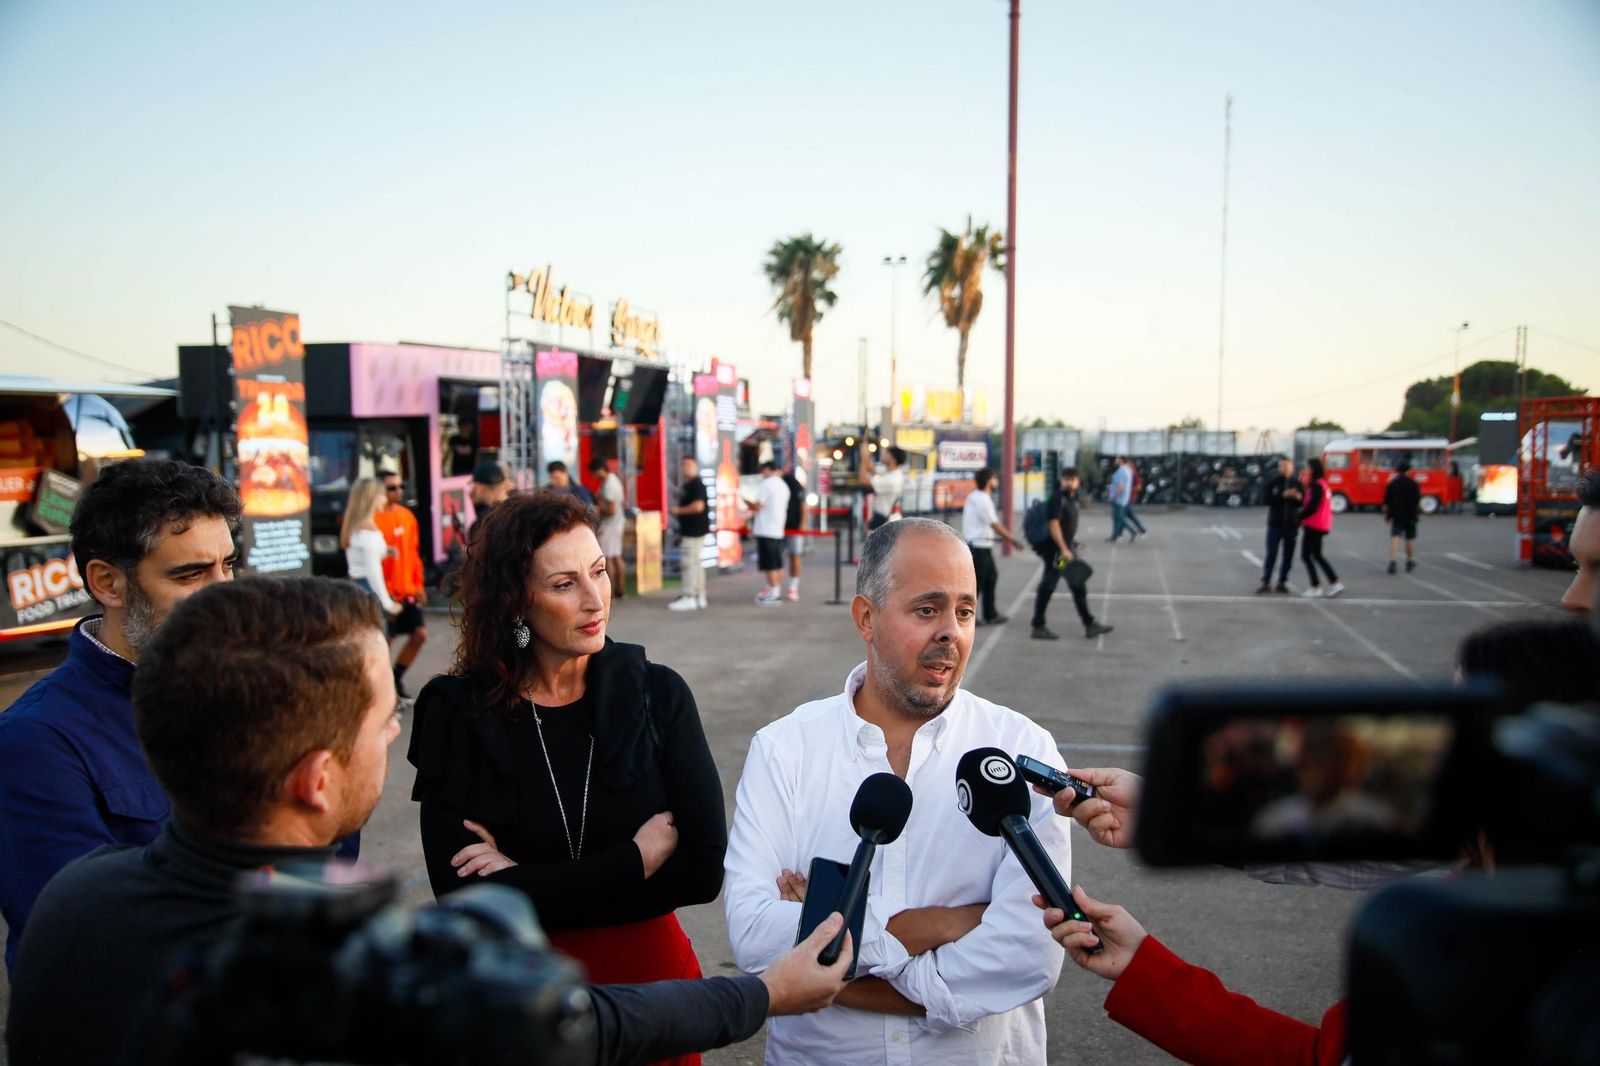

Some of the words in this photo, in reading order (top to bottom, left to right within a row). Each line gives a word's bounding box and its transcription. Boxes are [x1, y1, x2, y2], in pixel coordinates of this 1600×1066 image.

[232, 315, 304, 373] RICO
[17, 600, 55, 625] FOOD
[56, 589, 92, 611] TRUC
[990, 766, 1006, 774] intv
